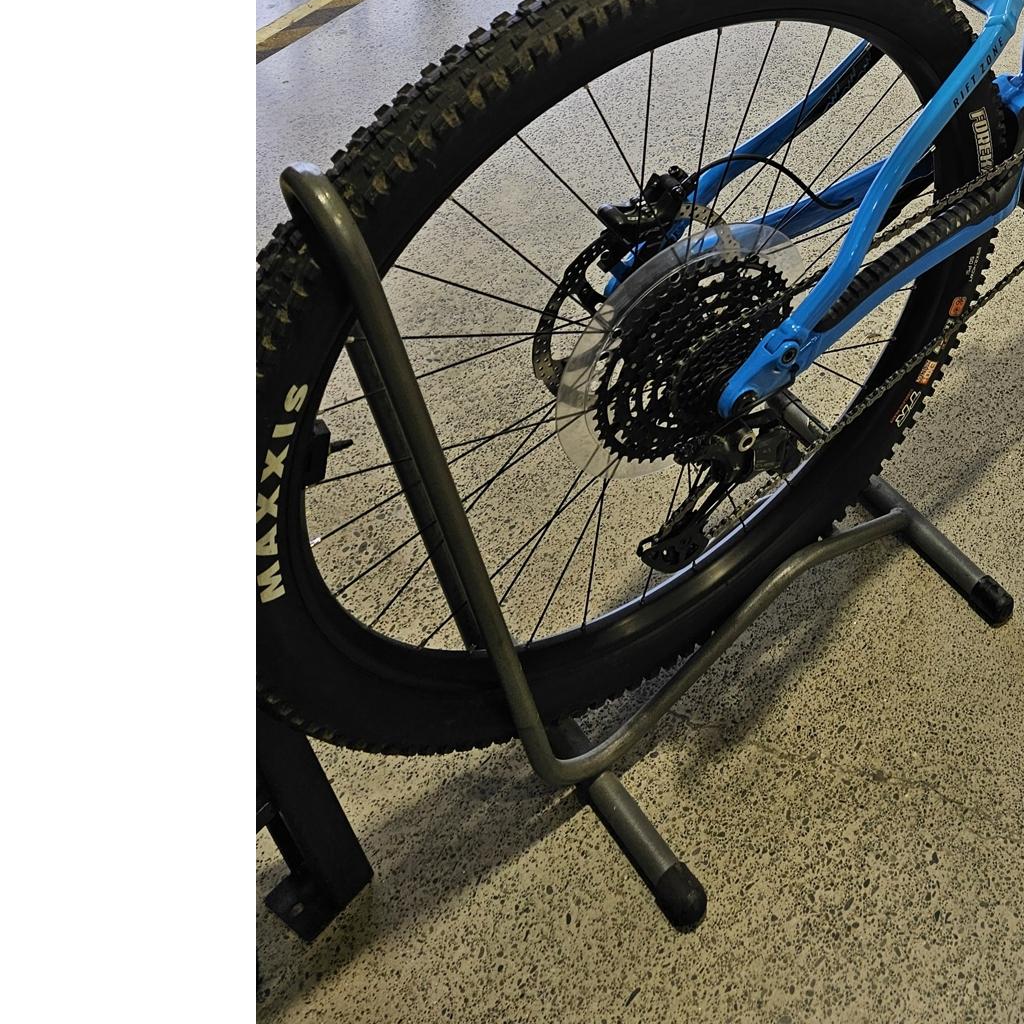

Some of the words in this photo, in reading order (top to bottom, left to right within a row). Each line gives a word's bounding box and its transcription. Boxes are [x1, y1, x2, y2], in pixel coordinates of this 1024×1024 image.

[953, 76, 977, 109] RIFT
[979, 37, 1005, 73] ZONE
[969, 107, 995, 175] FOREK
[256, 383, 308, 603] MAXXIS
